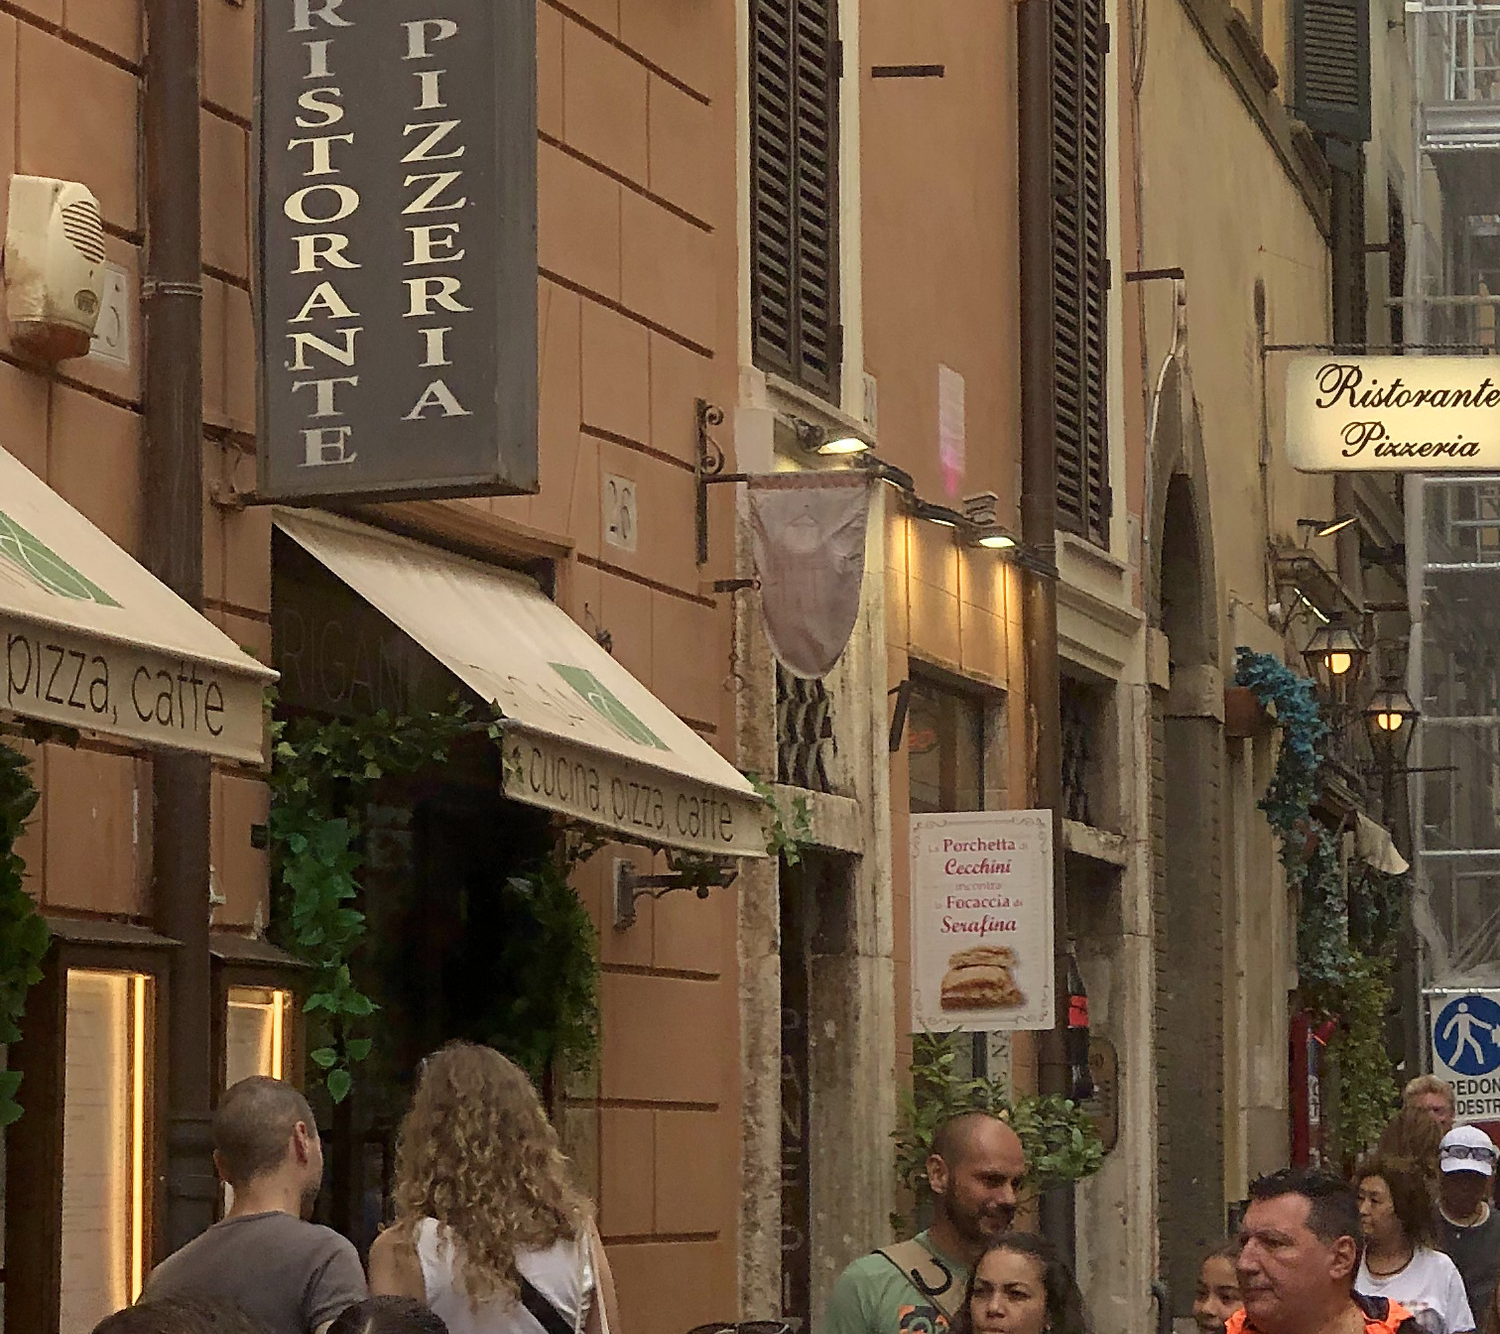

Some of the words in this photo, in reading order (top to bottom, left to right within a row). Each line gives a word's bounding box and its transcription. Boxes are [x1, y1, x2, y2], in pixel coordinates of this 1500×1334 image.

[400, 18, 474, 421] PIZZERIA
[1340, 421, 1481, 458] Pizzeria
[943, 837, 1016, 853] Porchetta
[944, 858, 1012, 876] Cecchini
[946, 895, 1010, 909] Focaccia
[940, 914, 1017, 938] Serafina
